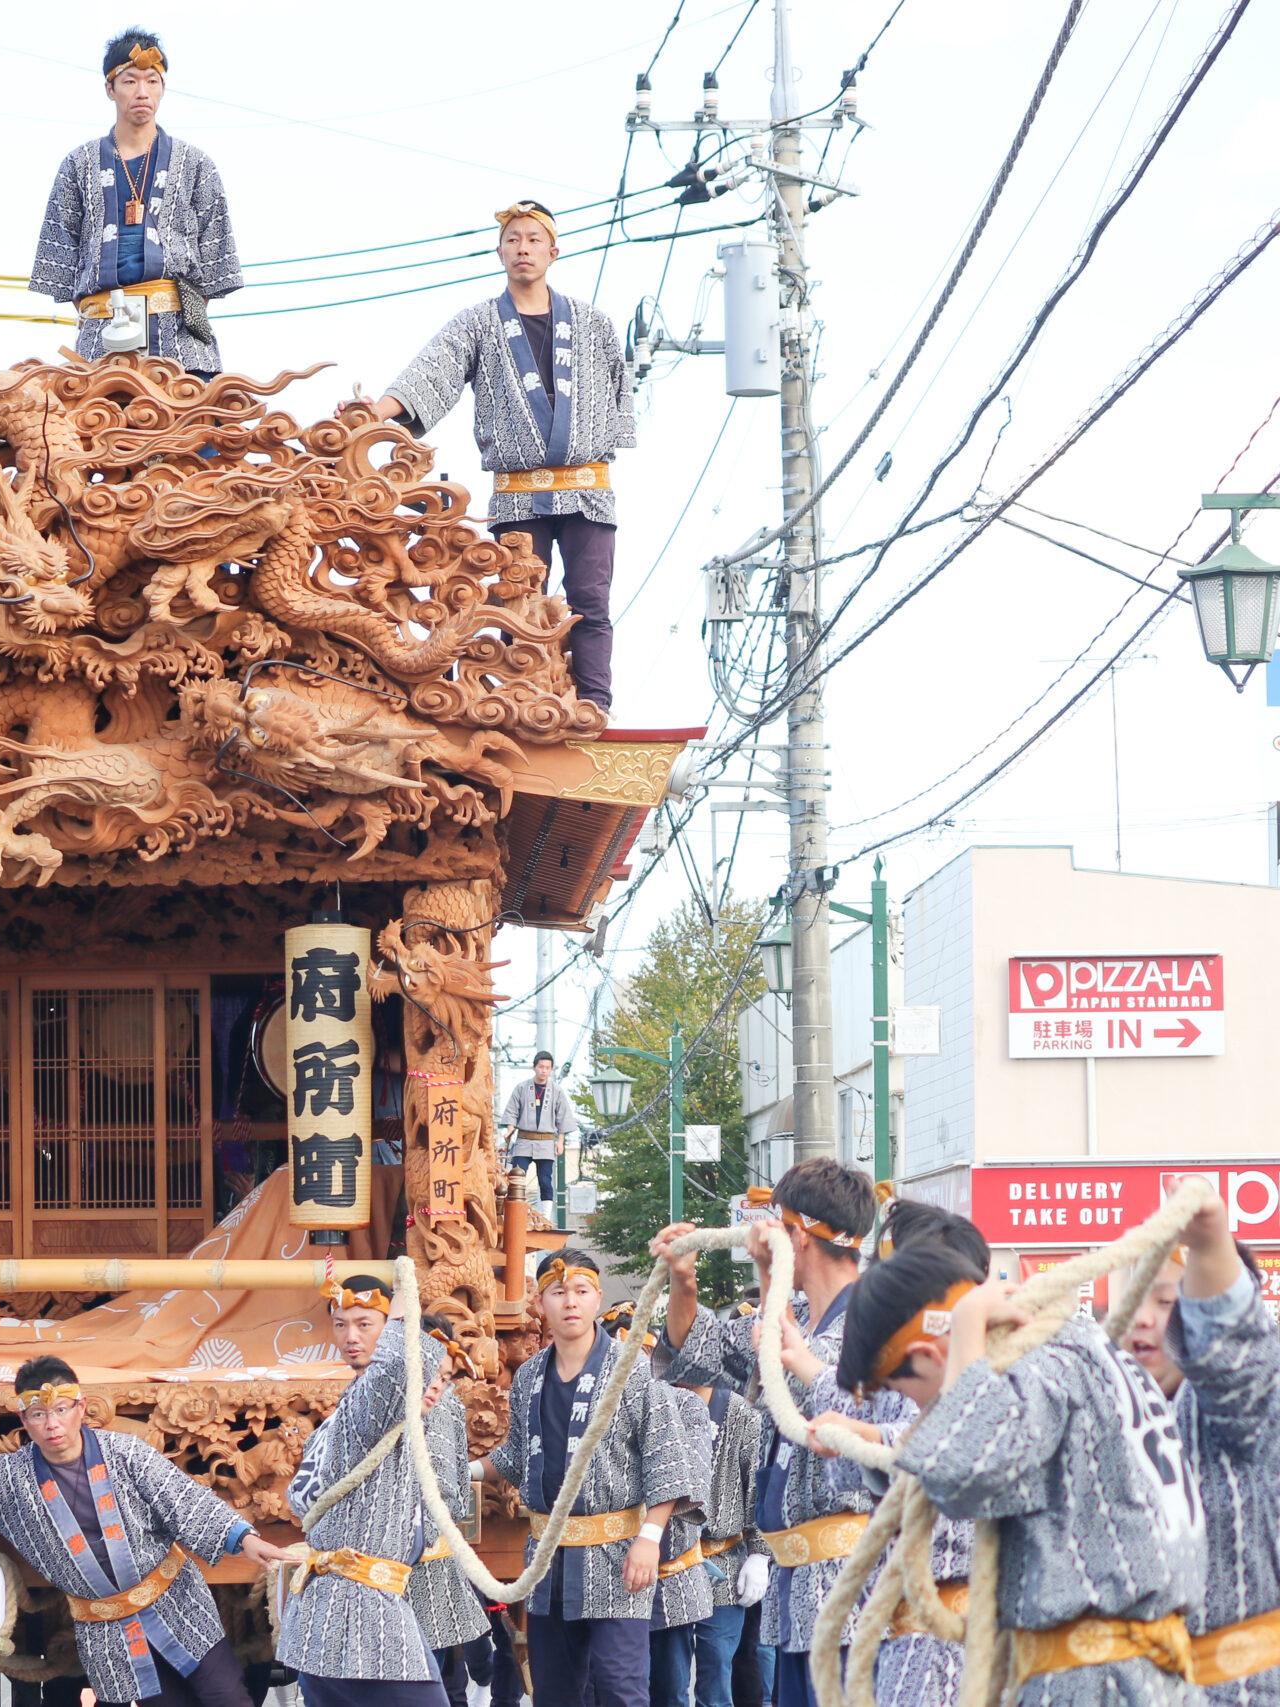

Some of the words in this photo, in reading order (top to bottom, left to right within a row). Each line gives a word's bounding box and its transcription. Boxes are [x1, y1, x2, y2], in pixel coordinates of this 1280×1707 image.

[1071, 996, 1121, 1009] JAPAN
[1127, 995, 1212, 1008] STANDARD
[1033, 1020, 1093, 1039] 駐車場
[1108, 1019, 1142, 1048] IN
[1033, 1040, 1093, 1050] PARKING
[290, 946, 363, 1208] 府所町
[430, 1095, 462, 1206] 府所町
[1009, 1181, 1124, 1200] DELIVERY
[1009, 1208, 1068, 1225] TAKE
[1079, 1207, 1124, 1225] OUT
